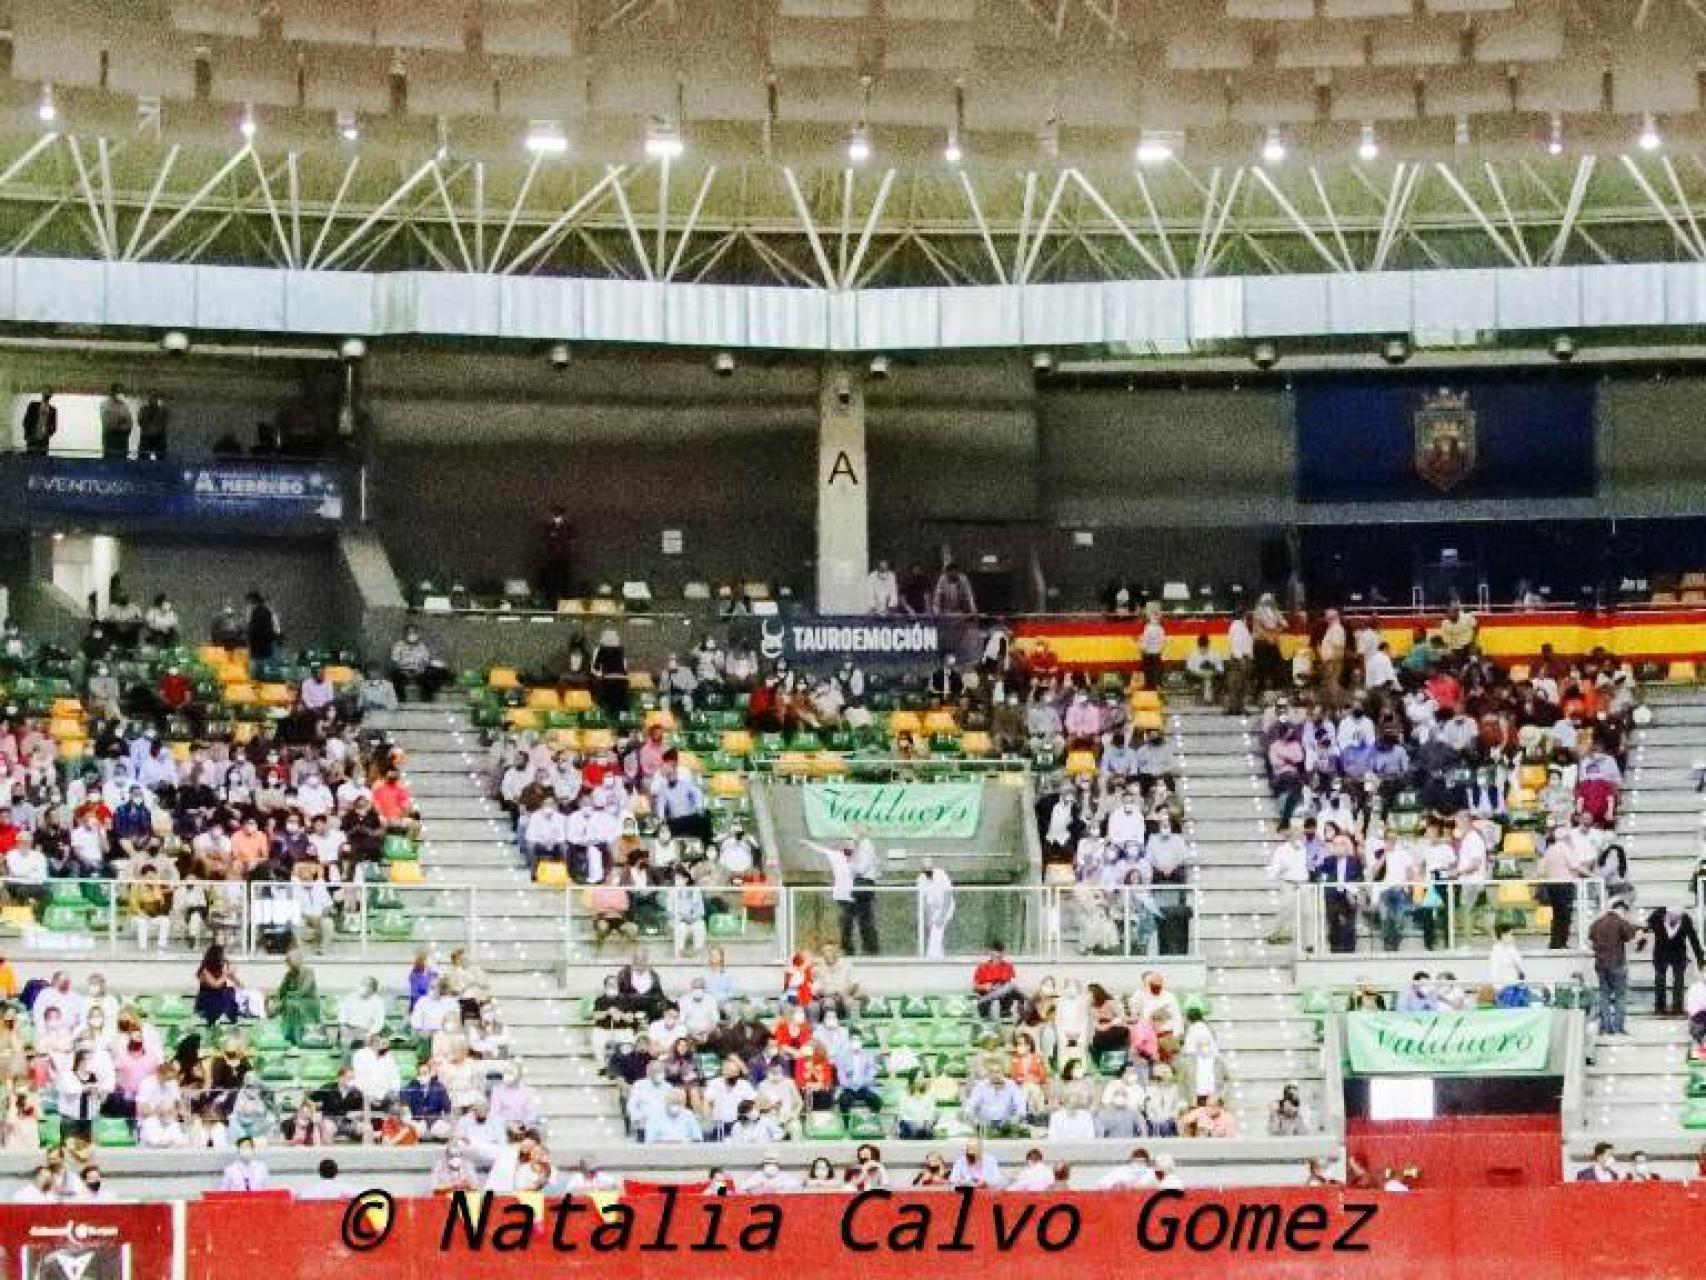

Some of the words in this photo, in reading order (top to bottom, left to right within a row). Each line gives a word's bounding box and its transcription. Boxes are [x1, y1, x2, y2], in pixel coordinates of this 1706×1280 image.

[828, 450, 857, 485] A
[792, 623, 938, 651] TAUROEMOCIÓN
[1375, 1016, 1533, 1055] Valduero
